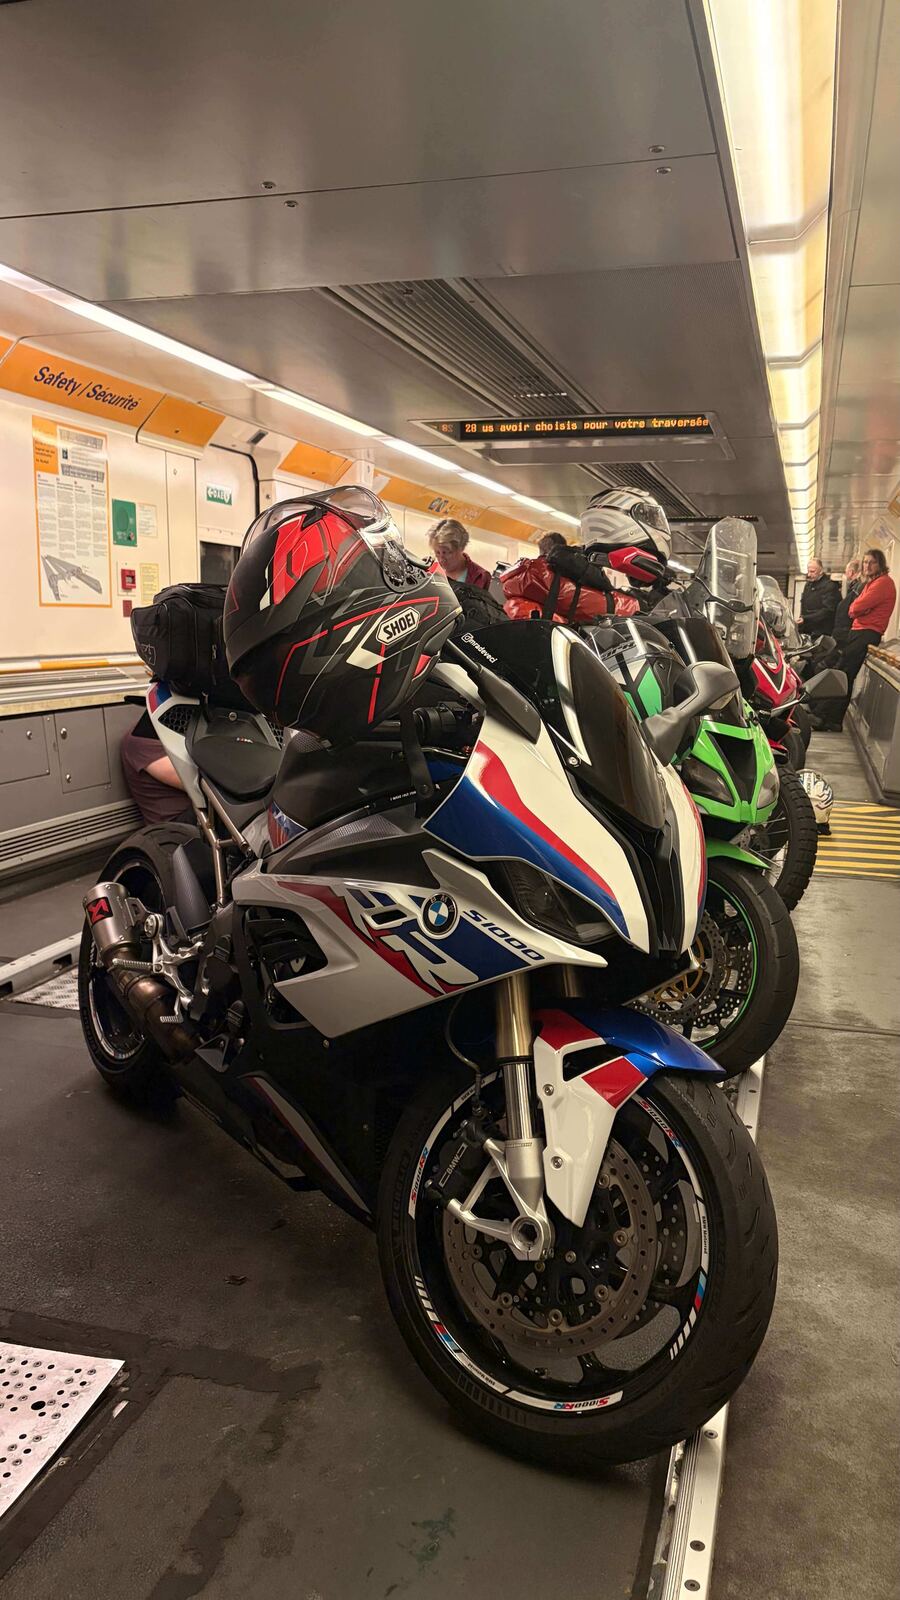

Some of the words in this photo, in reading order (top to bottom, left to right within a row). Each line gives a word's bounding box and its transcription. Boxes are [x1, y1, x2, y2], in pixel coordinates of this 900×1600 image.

[465, 423, 477, 433] 28
[482, 424, 494, 433] us
[500, 422, 530, 432] avoir
[535, 420, 578, 431] choisis
[584, 420, 608, 430] pour
[614, 418, 646, 429] votre
[652, 416, 709, 428] traversée
[383, 608, 417, 640] SHOEI
[462, 909, 546, 962] S1000
[446, 1153, 461, 1175] BMW
[553, 1396, 610, 1410] S1000RR
